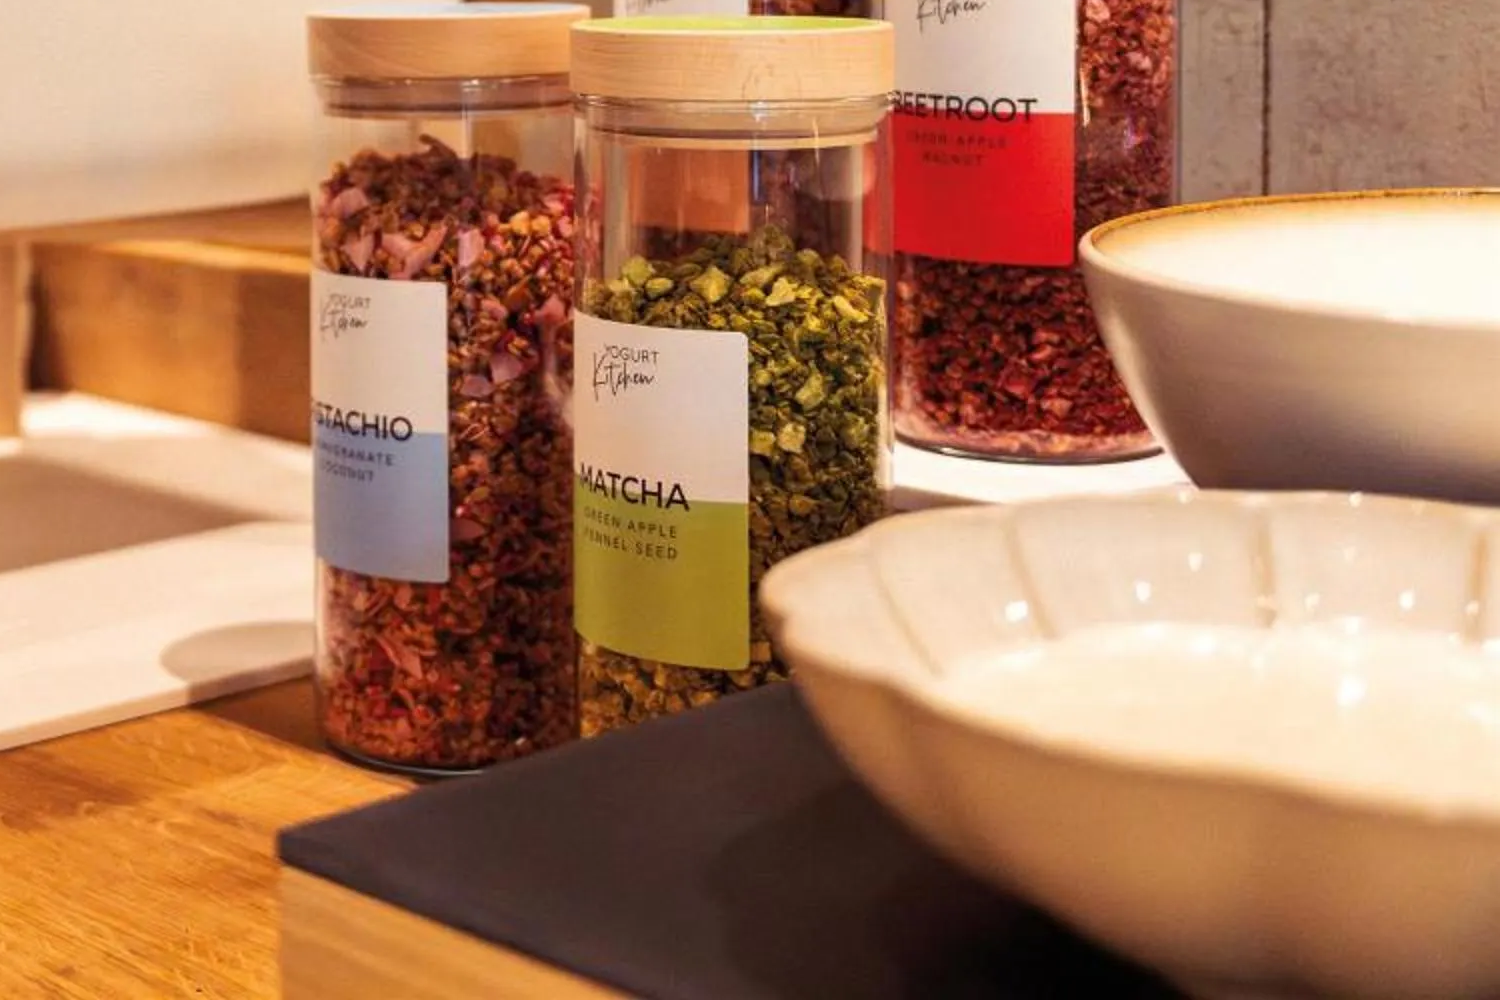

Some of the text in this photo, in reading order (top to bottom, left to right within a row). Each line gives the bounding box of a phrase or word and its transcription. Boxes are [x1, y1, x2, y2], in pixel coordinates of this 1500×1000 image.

[603, 343, 660, 364] YOGURT
[316, 401, 413, 442] STACHIO
[580, 462, 690, 512] MATCHA
[627, 519, 677, 538] APPLE
[635, 541, 678, 560] SEED
